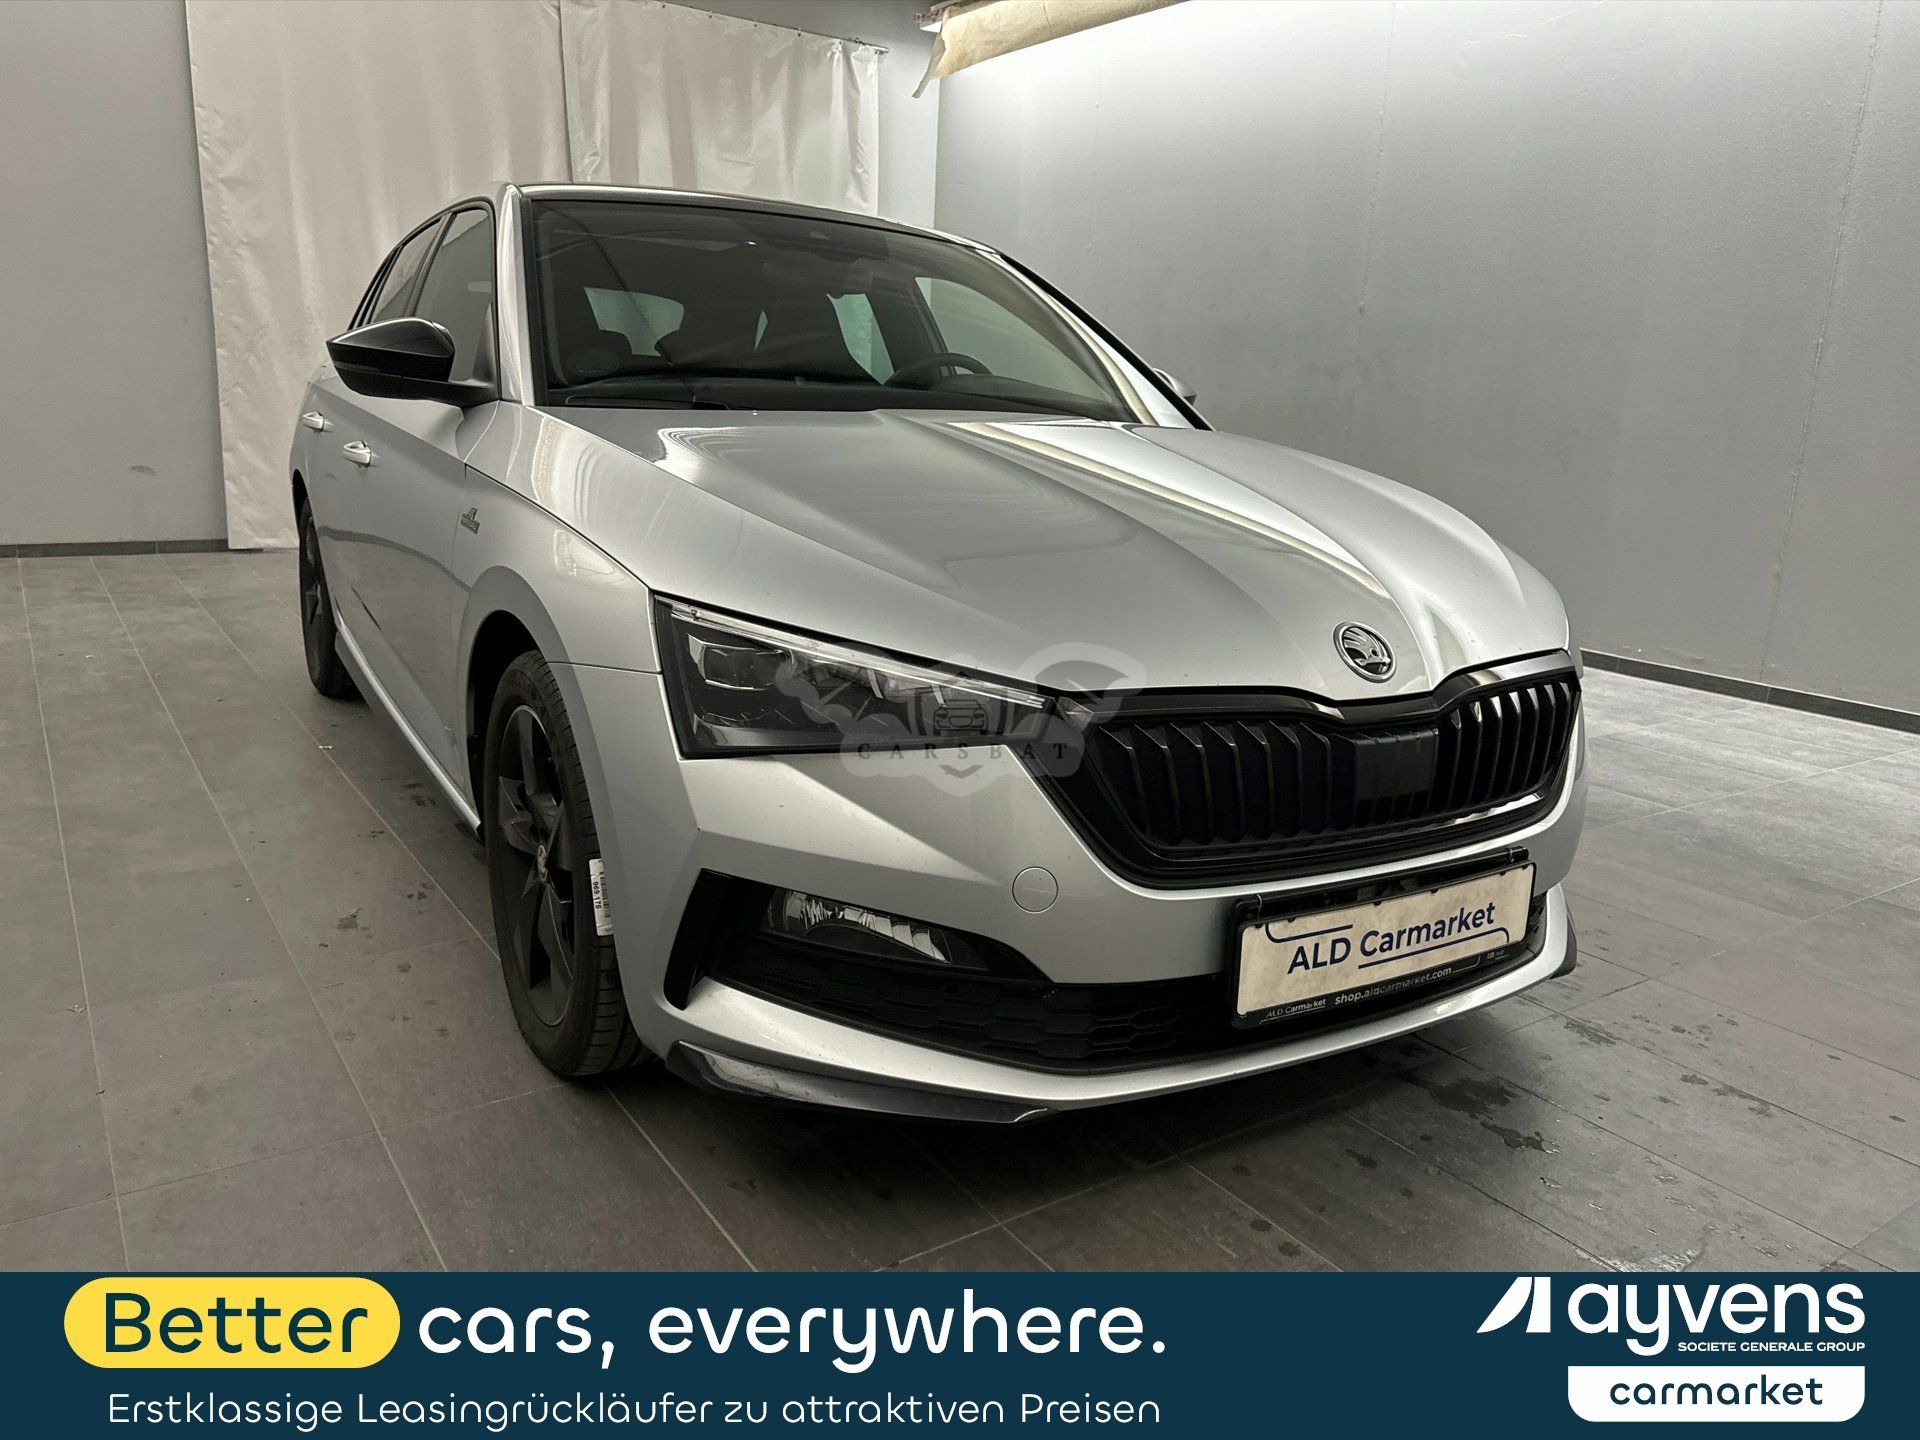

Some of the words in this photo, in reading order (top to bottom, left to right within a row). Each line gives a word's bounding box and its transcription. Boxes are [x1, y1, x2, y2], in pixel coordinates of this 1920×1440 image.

[1287, 936, 1352, 975] ALD
[1360, 902, 1496, 957] Carmarket
[1334, 967, 1452, 1005] shop.aldcarmarket.com
[1266, 1008, 1284, 1019] ALD
[1285, 998, 1327, 1014] Carmarket
